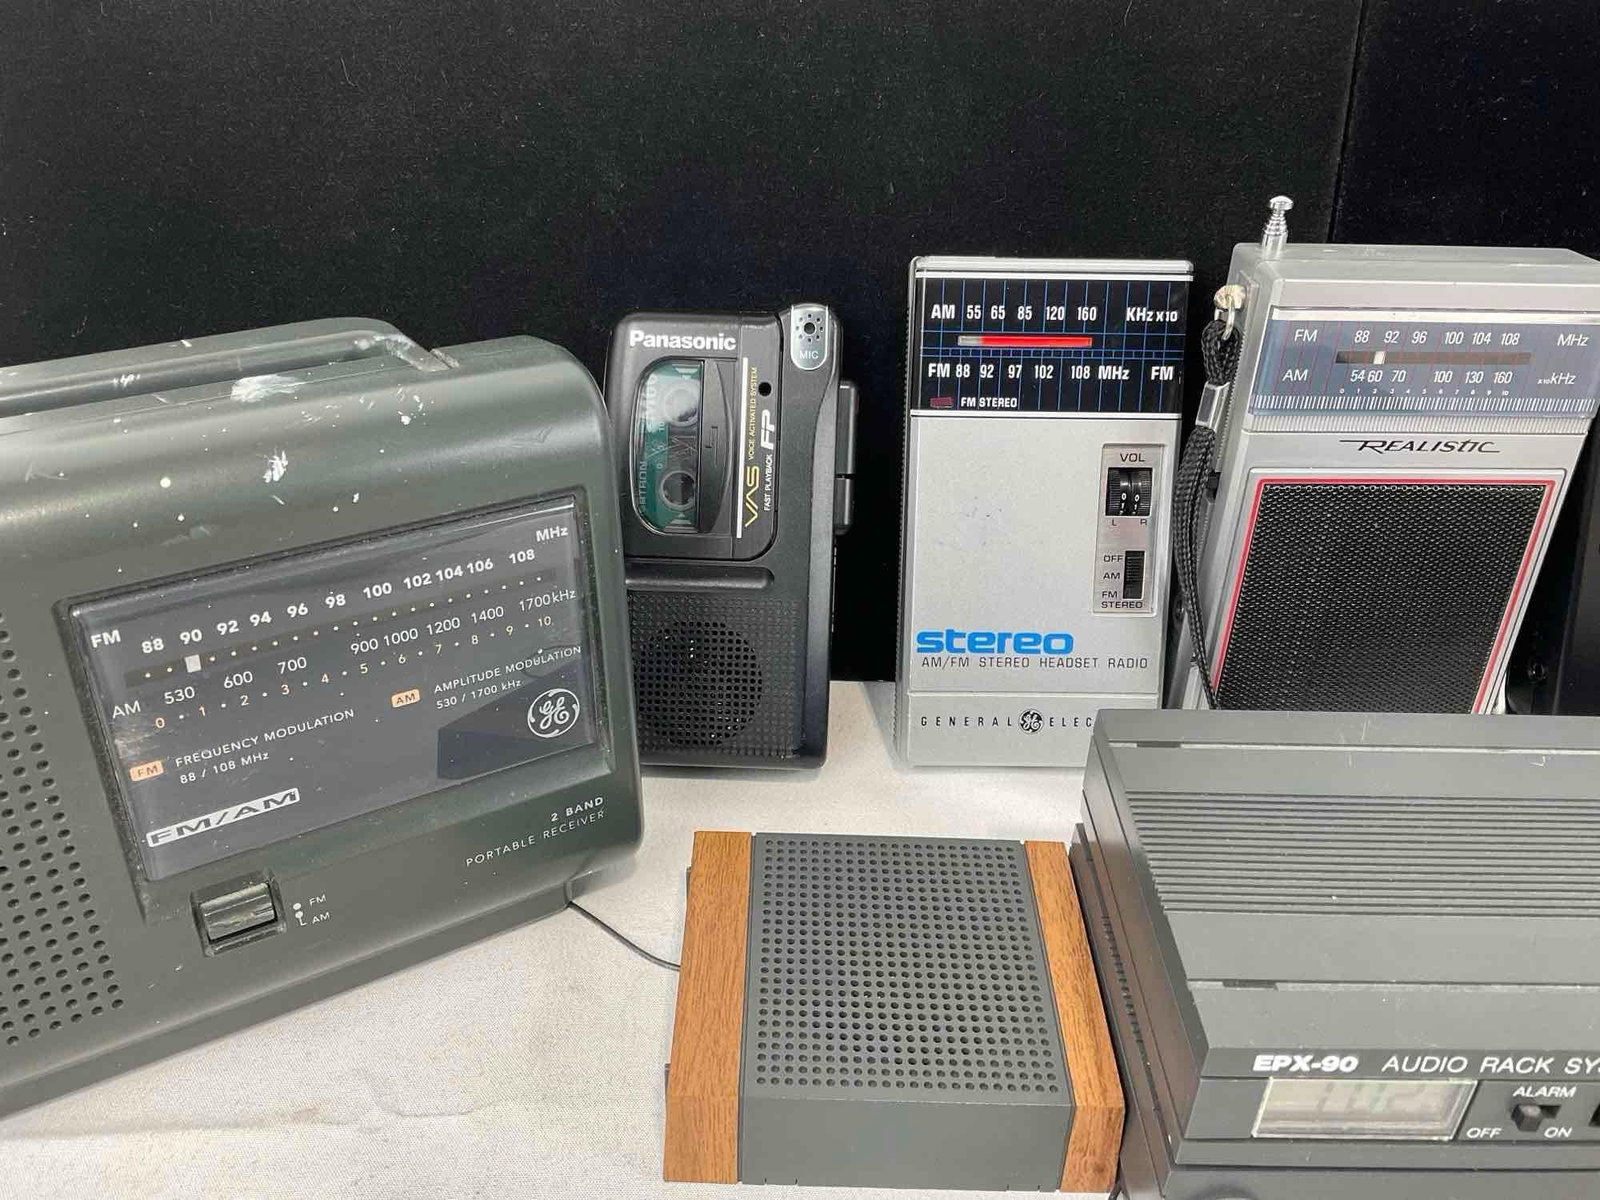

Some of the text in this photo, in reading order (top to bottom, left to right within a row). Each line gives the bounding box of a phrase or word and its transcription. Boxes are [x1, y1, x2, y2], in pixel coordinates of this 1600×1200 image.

[931, 304, 955, 319] AM
[966, 305, 982, 320] 55
[990, 305, 1006, 320] 65
[1017, 306, 1033, 320] 85
[1045, 306, 1065, 321] 120
[1077, 306, 1097, 321] 160
[1126, 307, 1154, 322] KHz
[629, 330, 737, 350] Panasonic
[1294, 329, 1588, 347] FM 88 92 96 100 104 108 MHz
[799, 350, 819, 360] MIC
[750, 366, 758, 396] SYSTEM
[928, 364, 1130, 380] FM 88 92 97 102 108 MHz
[1150, 366, 1174, 380] FM
[1282, 370, 1308, 382] AM
[1350, 370, 1366, 382] 54
[1367, 370, 1382, 382] 60
[1391, 370, 1406, 382] 70
[1433, 371, 1452, 383] 100
[1465, 371, 1483, 383] 130
[1493, 371, 1512, 384] 160
[960, 397, 1018, 408] FM STEREO
[748, 439, 756, 460] VOICE
[1120, 453, 1145, 463] VOL
[761, 409, 775, 511] FAST PLAYBACK FP
[744, 465, 760, 527] VAS
[535, 525, 569, 543] MHz
[1103, 555, 1123, 563] OFF
[1103, 572, 1120, 580] AM
[90, 549, 536, 654] FM 88 90 92 94 96 98 100 102 104 106 108
[1101, 601, 1143, 609] STEREO
[916, 629, 1074, 655] stereo
[112, 588, 577, 719] AM 530 600 700 900 1000 1200 1400 1700 kHz
[155, 616, 551, 729] 0 1 2 3 4 5 6 7 8 9 10
[921, 657, 1148, 670] AM/FM STEREO HEADSET RADIO
[396, 646, 581, 704] AM AMPLITUDE MODULATION
[436, 697, 457, 710] 530
[471, 684, 498, 700] 1700
[501, 679, 521, 691] kHz
[921, 717, 1012, 727] GENERAL
[1049, 717, 1092, 728] ELEC
[137, 709, 355, 778] FM FREQUENCY MODULATION
[180, 772, 196, 784] 88
[212, 760, 236, 776] 108
[241, 752, 270, 766] MHz
[150, 790, 297, 845] FM/AM
[550, 797, 604, 822] 2 BAND
[465, 810, 605, 867] PORTABLE RECEIVER
[309, 894, 327, 906] FM
[312, 912, 330, 924] AM
[1253, 1055, 1359, 1072] EPX-90
[1381, 1056, 1468, 1073] AUDIO
[1480, 1056, 1553, 1074] RACK
[1513, 1086, 1577, 1098] ALARM
[1466, 1127, 1572, 1139] OFF ON
